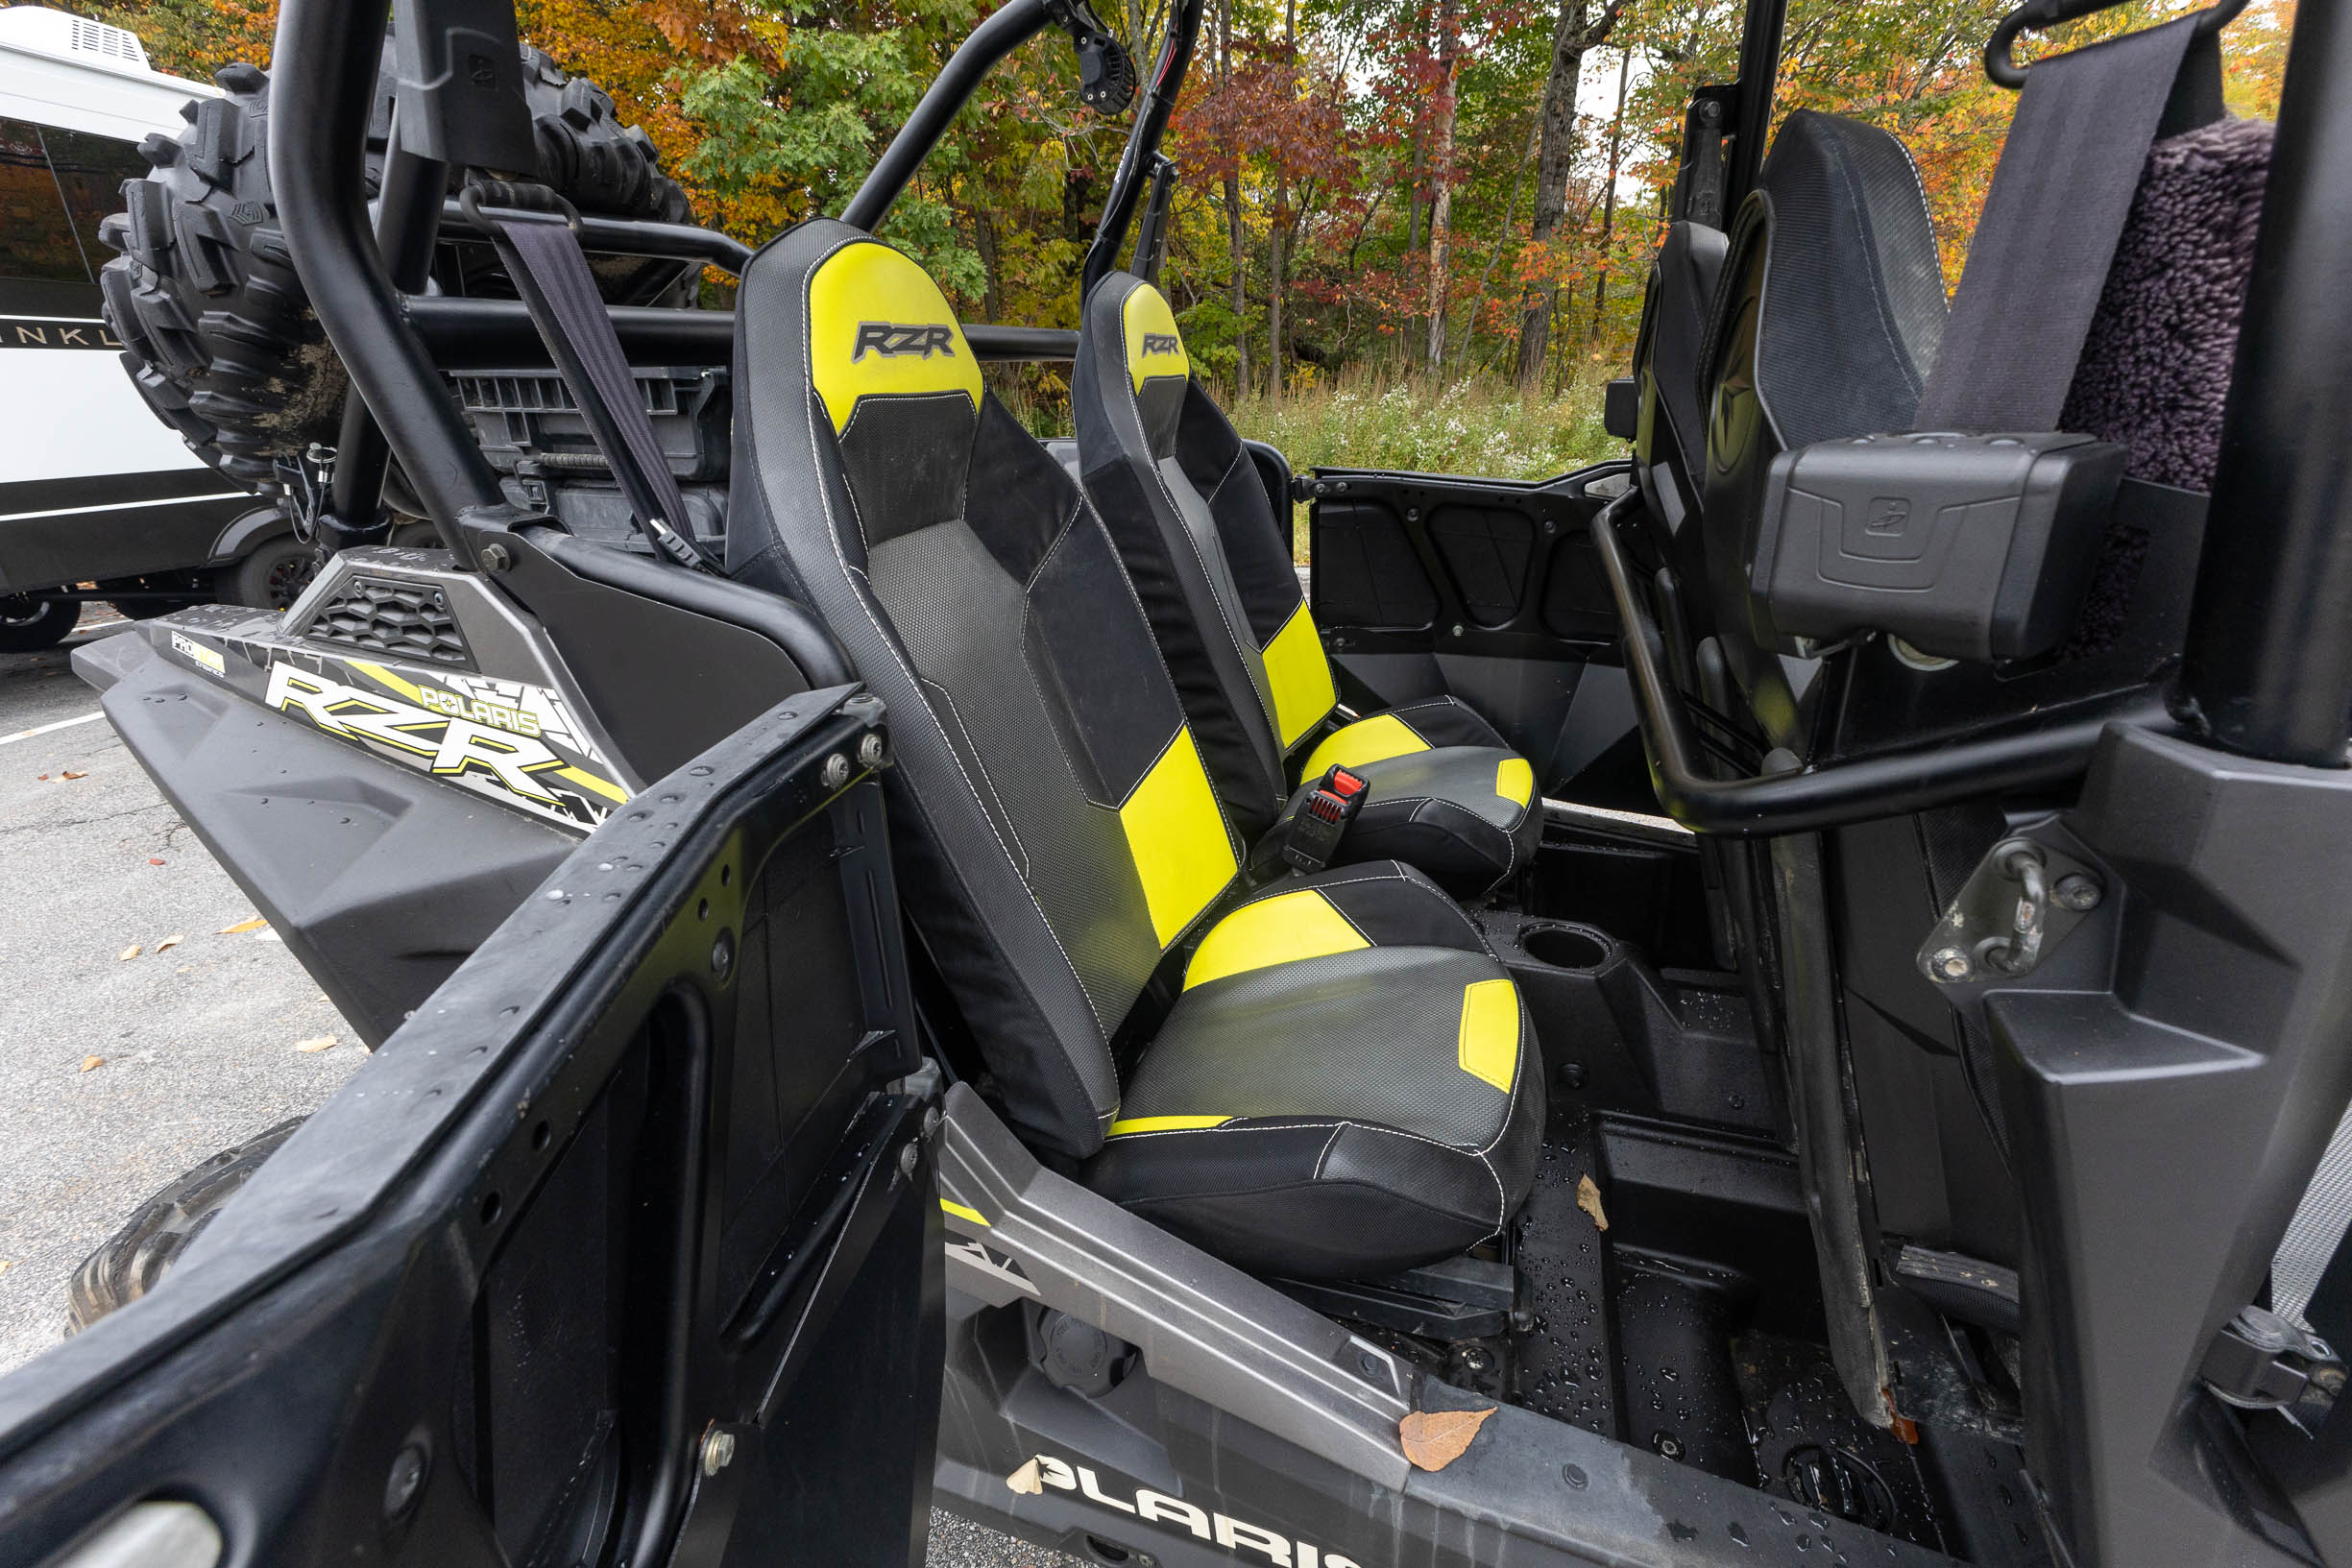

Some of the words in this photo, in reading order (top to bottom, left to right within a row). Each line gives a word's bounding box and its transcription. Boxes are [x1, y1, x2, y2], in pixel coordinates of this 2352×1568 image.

[852, 321, 955, 364] RZR
[1142, 332, 1179, 358] RZR
[264, 661, 567, 808] RZR
[418, 684, 542, 737] POLARIS
